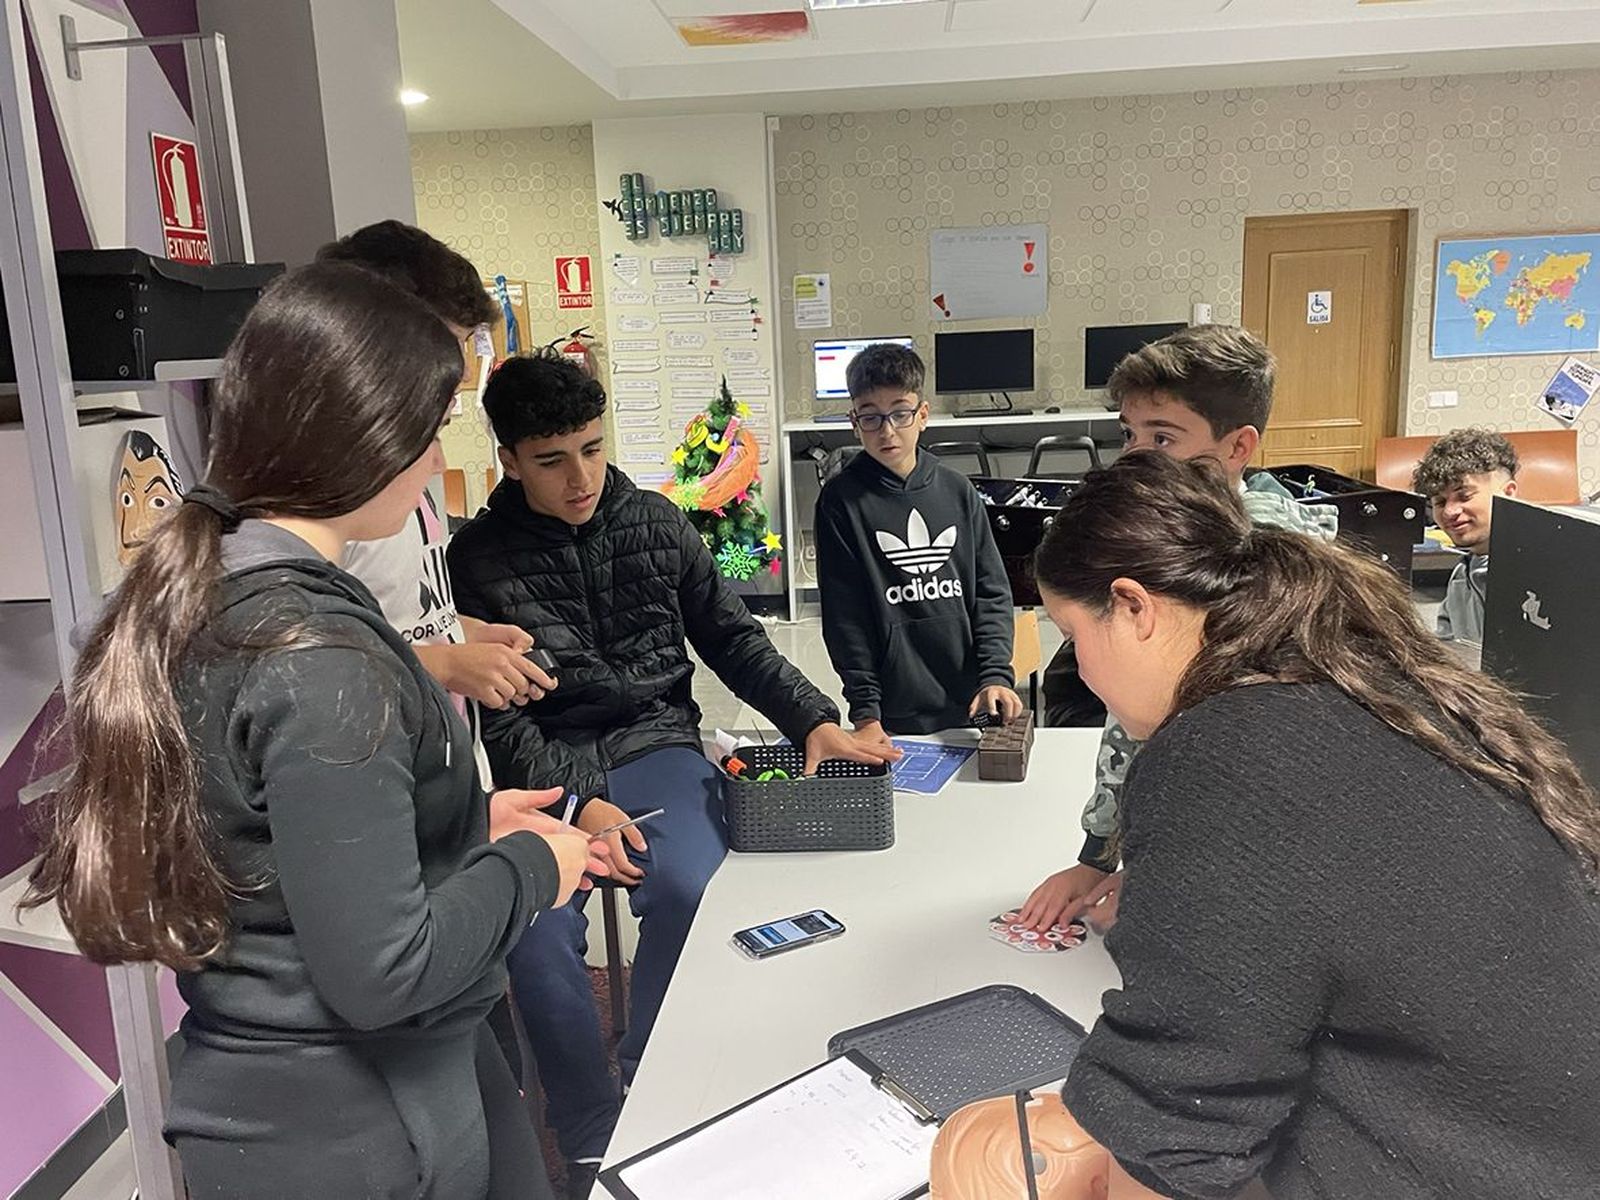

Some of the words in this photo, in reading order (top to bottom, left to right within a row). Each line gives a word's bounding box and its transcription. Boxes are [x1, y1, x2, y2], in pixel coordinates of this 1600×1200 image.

[620, 173, 641, 190] EL
[621, 190, 716, 214] COMIENZO
[625, 219, 647, 236] ES
[660, 211, 742, 234] SIEMPRE
[168, 237, 210, 260] EXTINTOR
[709, 233, 744, 249] HOY
[560, 296, 591, 306] EXTINTOR
[885, 575, 963, 605] adidas
